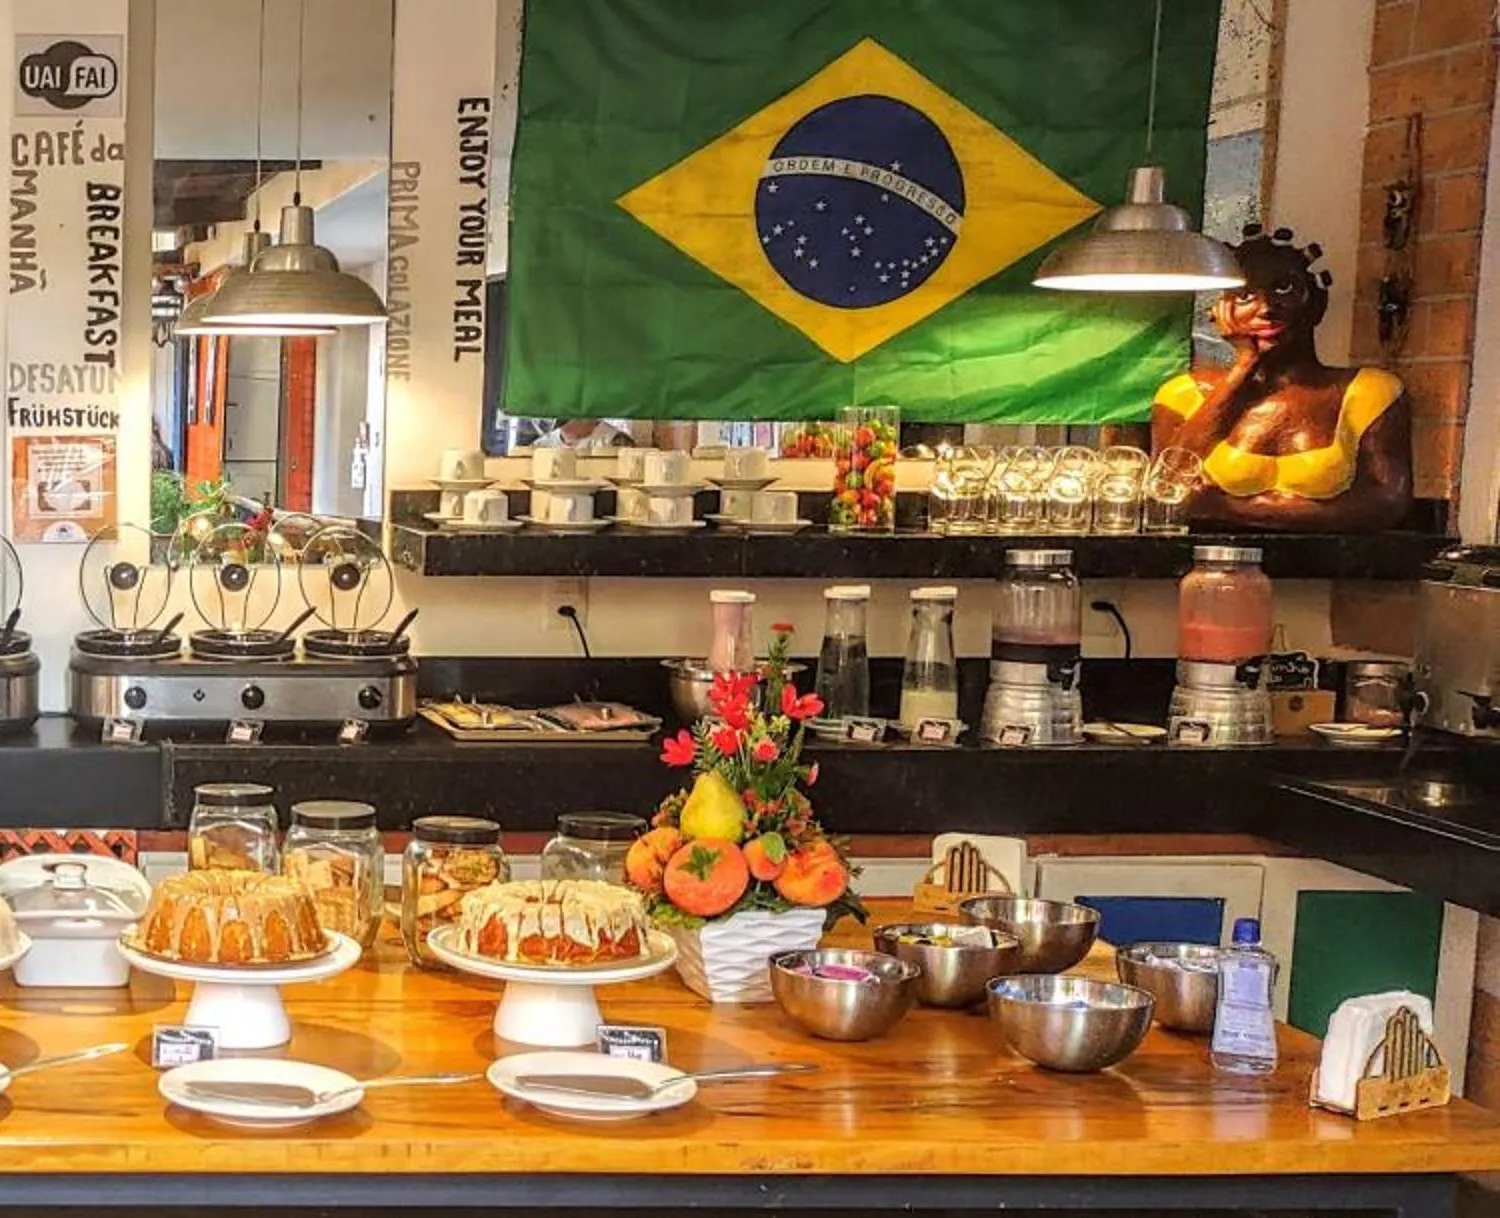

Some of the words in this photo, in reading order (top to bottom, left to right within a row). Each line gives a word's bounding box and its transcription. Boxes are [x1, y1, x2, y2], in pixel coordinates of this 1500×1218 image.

[24, 65, 61, 89] UAI
[75, 66, 106, 89] FAI
[11, 119, 85, 167] CAFÉ
[90, 133, 124, 163] da
[456, 96, 491, 189] ENJOY
[9, 169, 47, 295] MANHÃ
[389, 161, 421, 253] PRIMA
[456, 197, 486, 267] YOUR
[84, 181, 123, 369] BREAKFAST
[453, 279, 483, 363] MEAL
